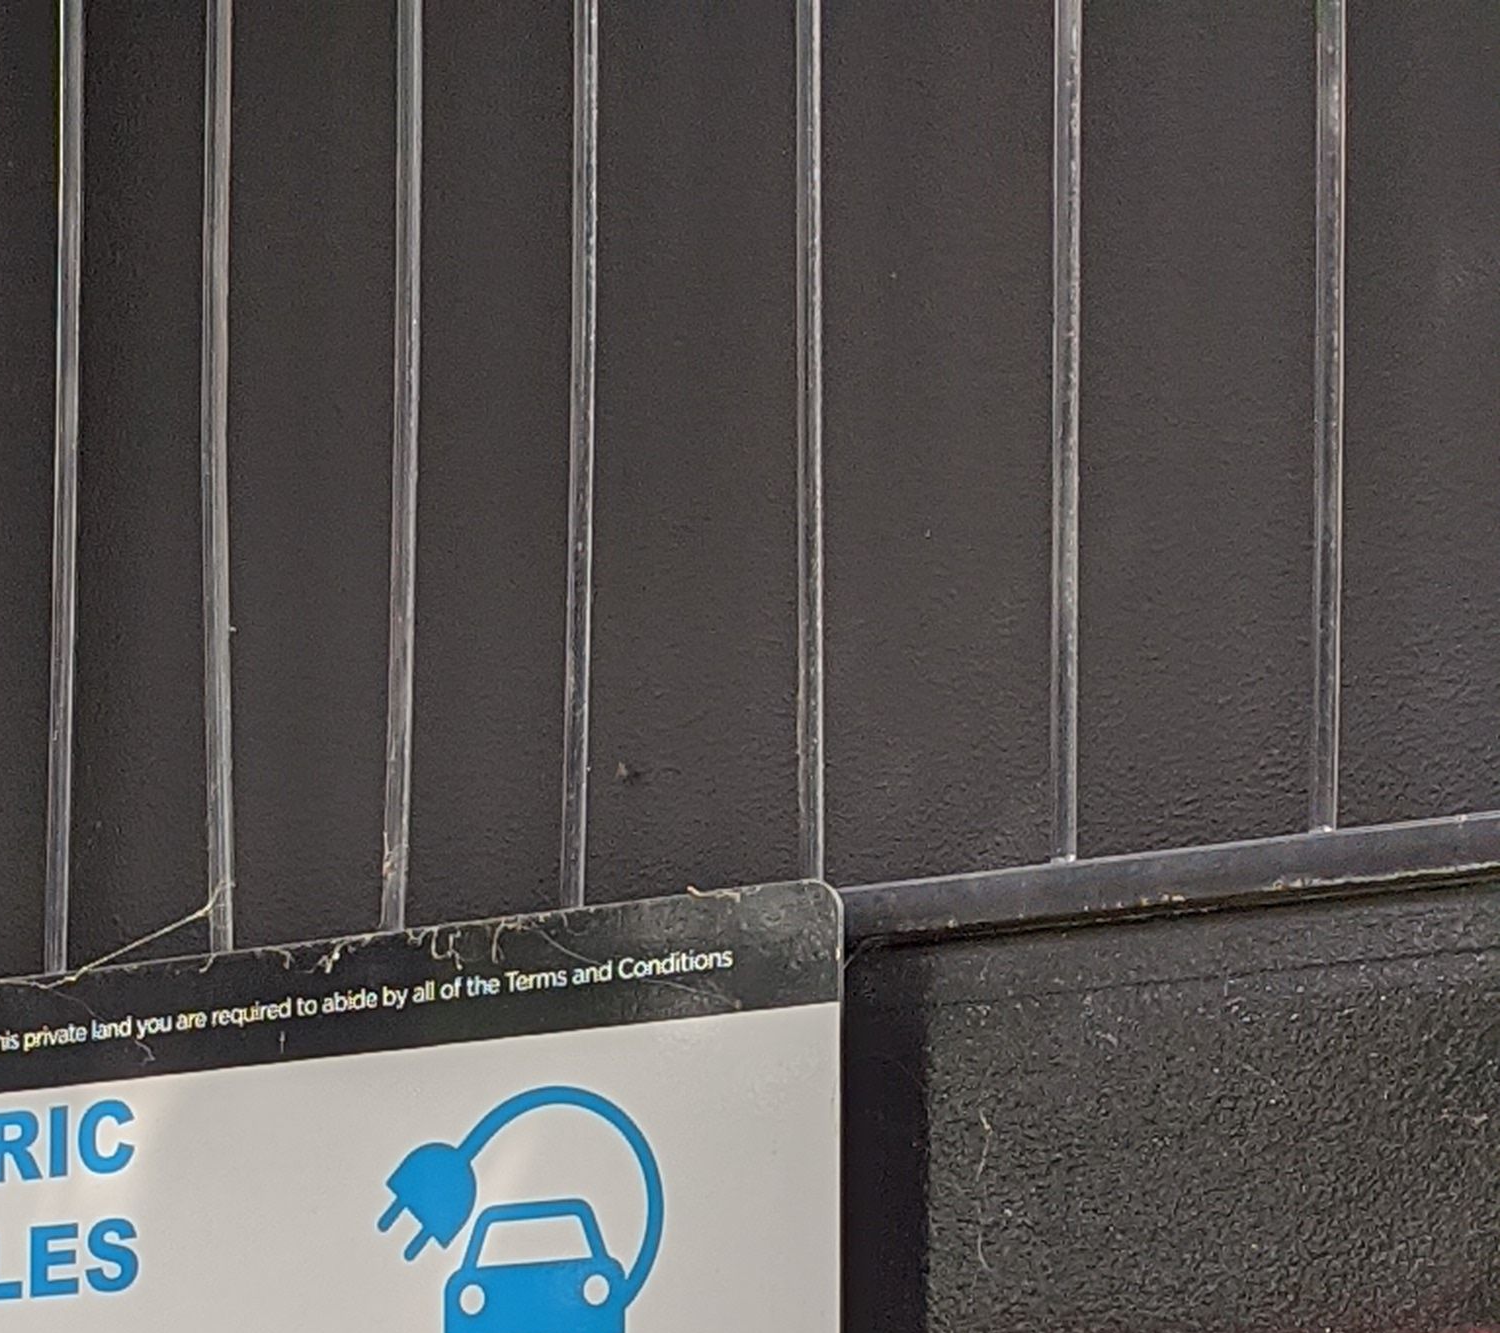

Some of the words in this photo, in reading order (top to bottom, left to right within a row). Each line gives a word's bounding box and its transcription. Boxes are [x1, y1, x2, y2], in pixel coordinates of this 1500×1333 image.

[23, 1023, 88, 1053] private
[91, 1014, 132, 1041] land
[136, 1013, 173, 1037] you
[175, 1010, 208, 1032] are
[211, 996, 292, 1028] required
[296, 996, 318, 1017] to
[321, 987, 378, 1014] abide
[382, 985, 409, 1010] by
[412, 979, 435, 1004] all
[439, 975, 462, 1001] of
[466, 974, 501, 998] the
[504, 969, 568, 993] Terms
[571, 959, 613, 986] and
[617, 948, 734, 980] Conditions
